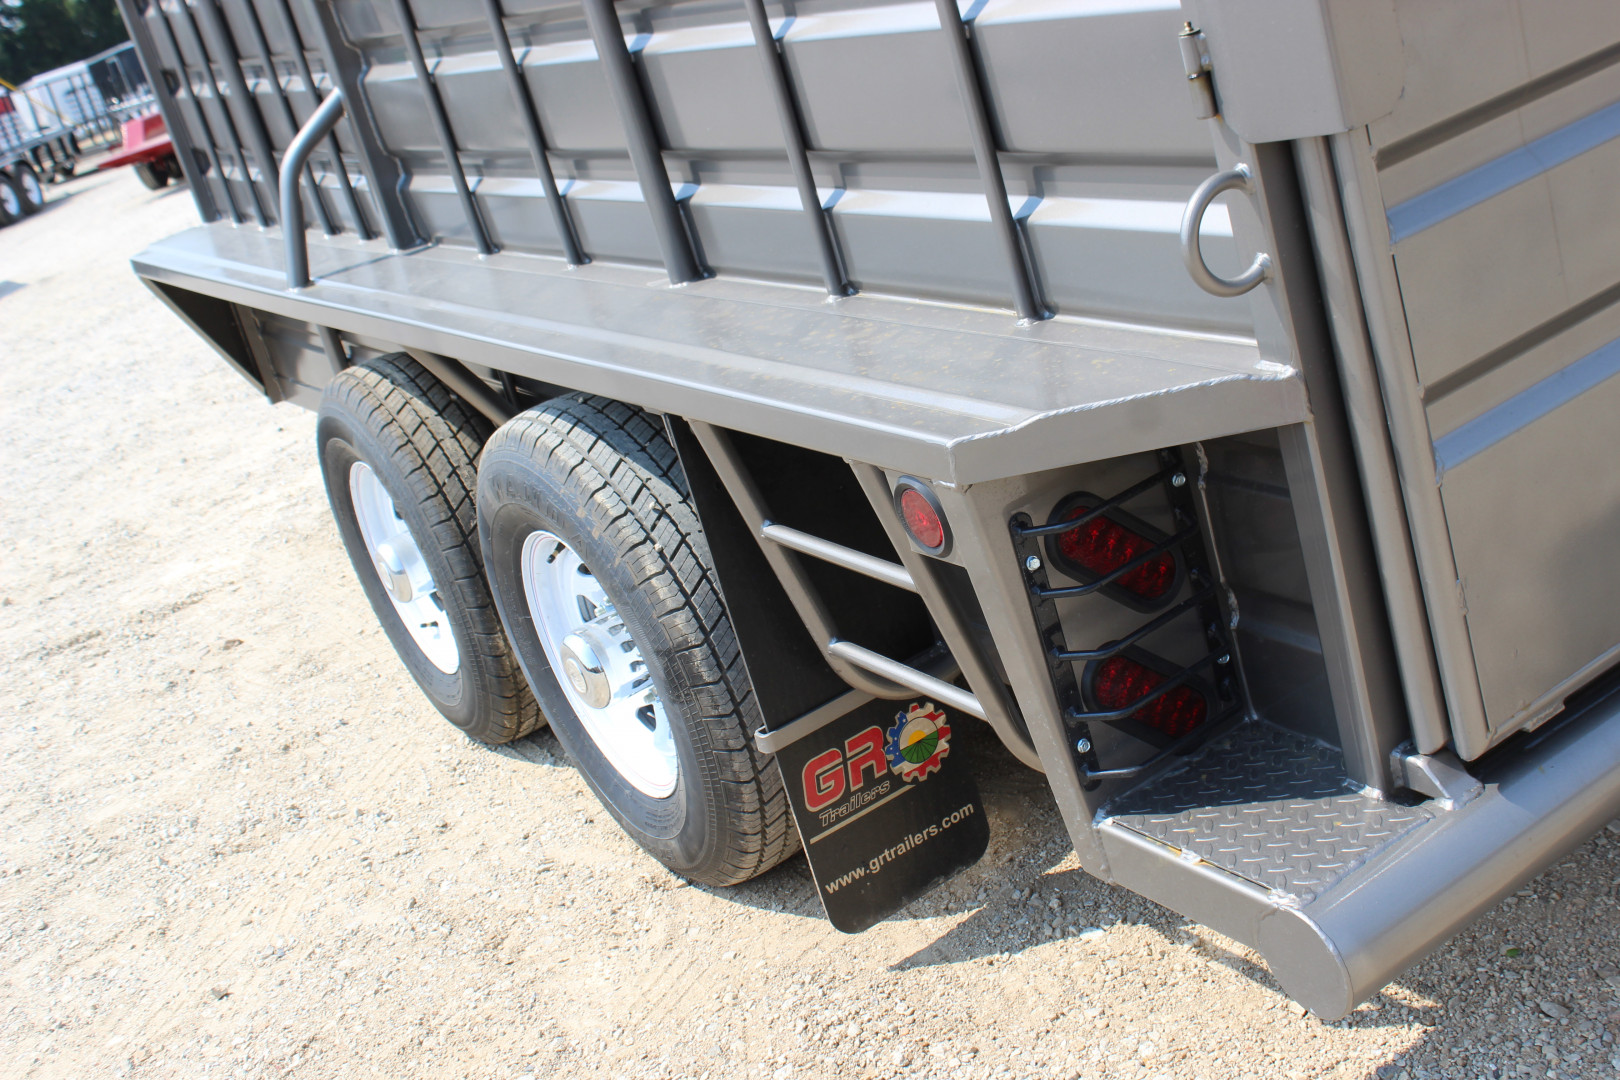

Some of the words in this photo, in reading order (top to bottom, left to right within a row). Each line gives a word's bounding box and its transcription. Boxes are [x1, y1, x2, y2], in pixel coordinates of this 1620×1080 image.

[802, 725, 888, 812] GR
[819, 780, 891, 827] Trailers
[825, 803, 975, 894] www.grtrailers.com
